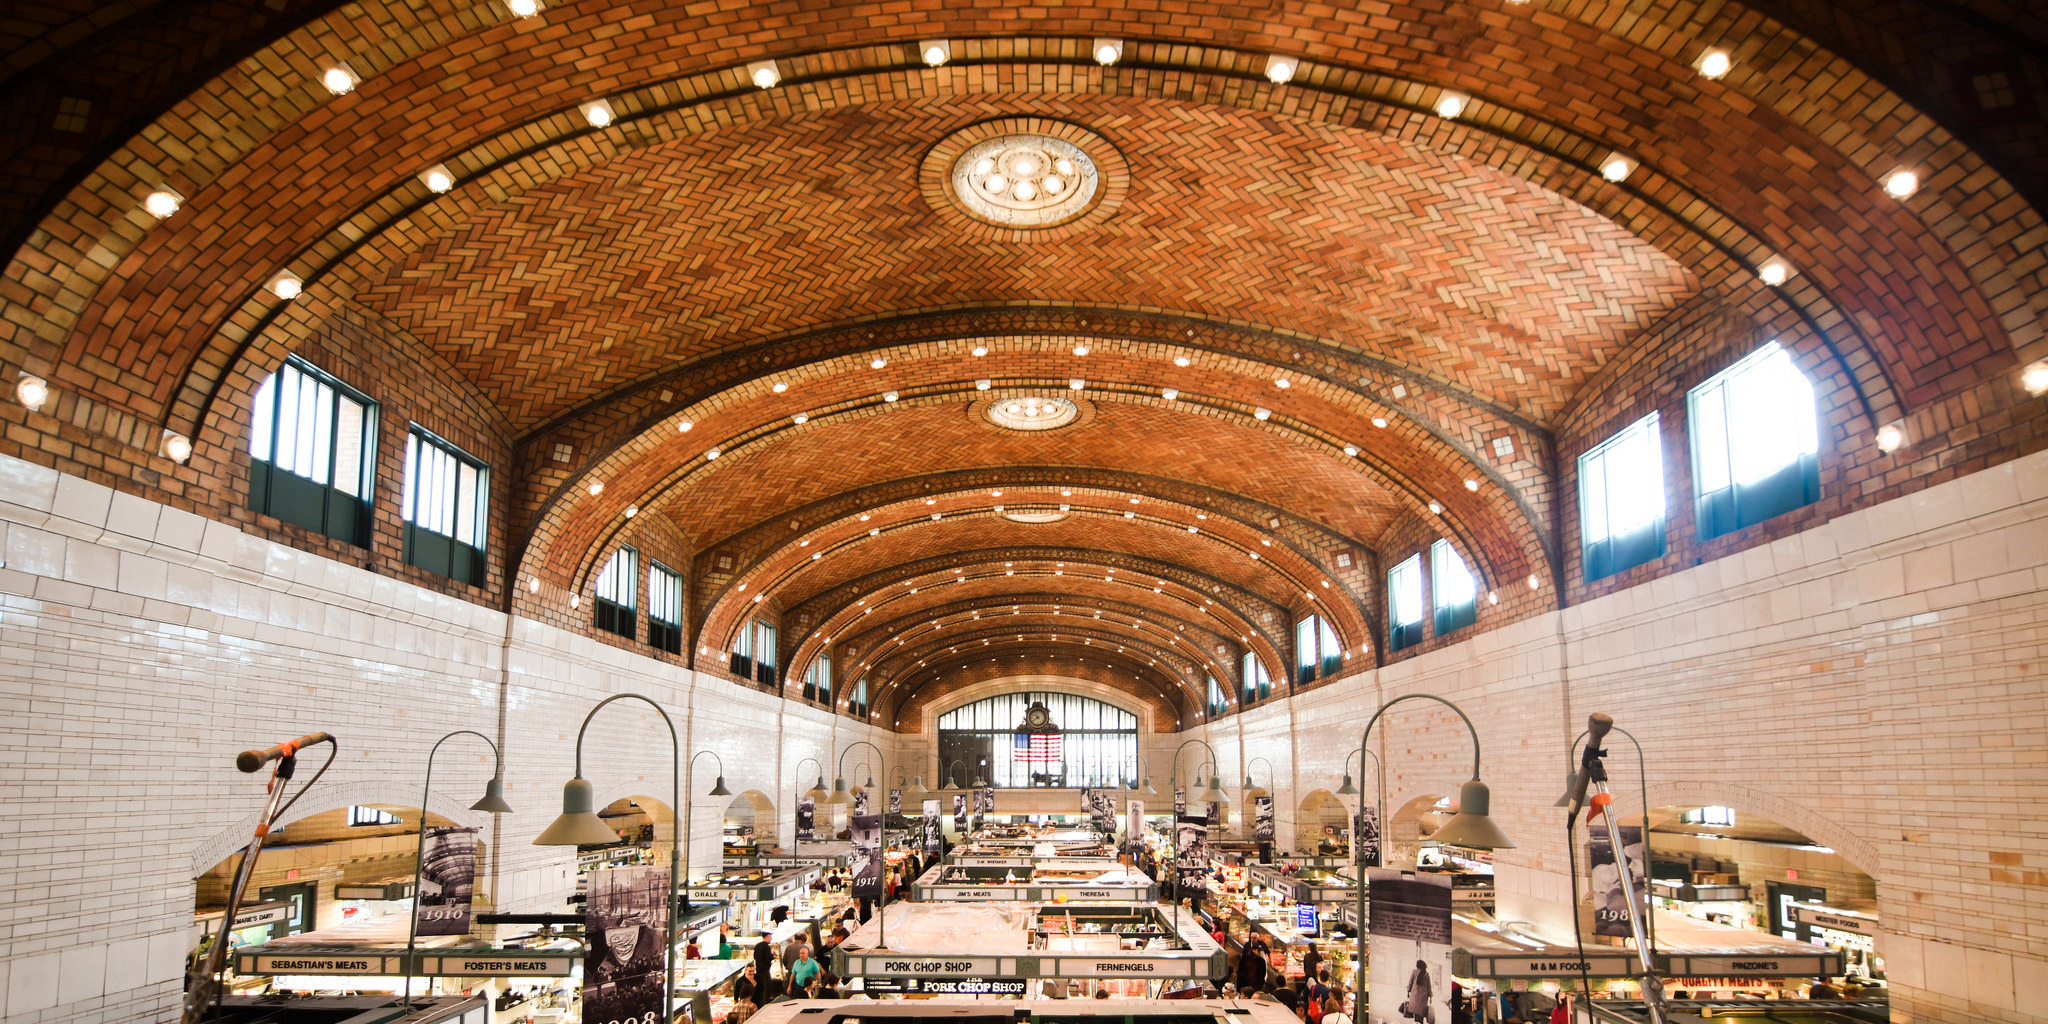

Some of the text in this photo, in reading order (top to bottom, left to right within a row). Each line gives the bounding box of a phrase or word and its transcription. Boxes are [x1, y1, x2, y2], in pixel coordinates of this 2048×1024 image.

[855, 876, 877, 888] 1917
[425, 909, 463, 922] 1910
[1599, 909, 1630, 922] 198
[1840, 919, 1860, 928] FOODS
[271, 960, 368, 971] SEBASTIAN'S MEATS
[464, 960, 547, 971] FOSTER'S MEATS
[885, 961, 972, 973] PORK CHOP SHOP
[1096, 963, 1154, 972] FERNENGELS
[1732, 962, 1779, 970] PINZONE'S
[923, 982, 1024, 992] PORK CHOP SHOP
[1682, 977, 1763, 988] QUALITY MEATS
